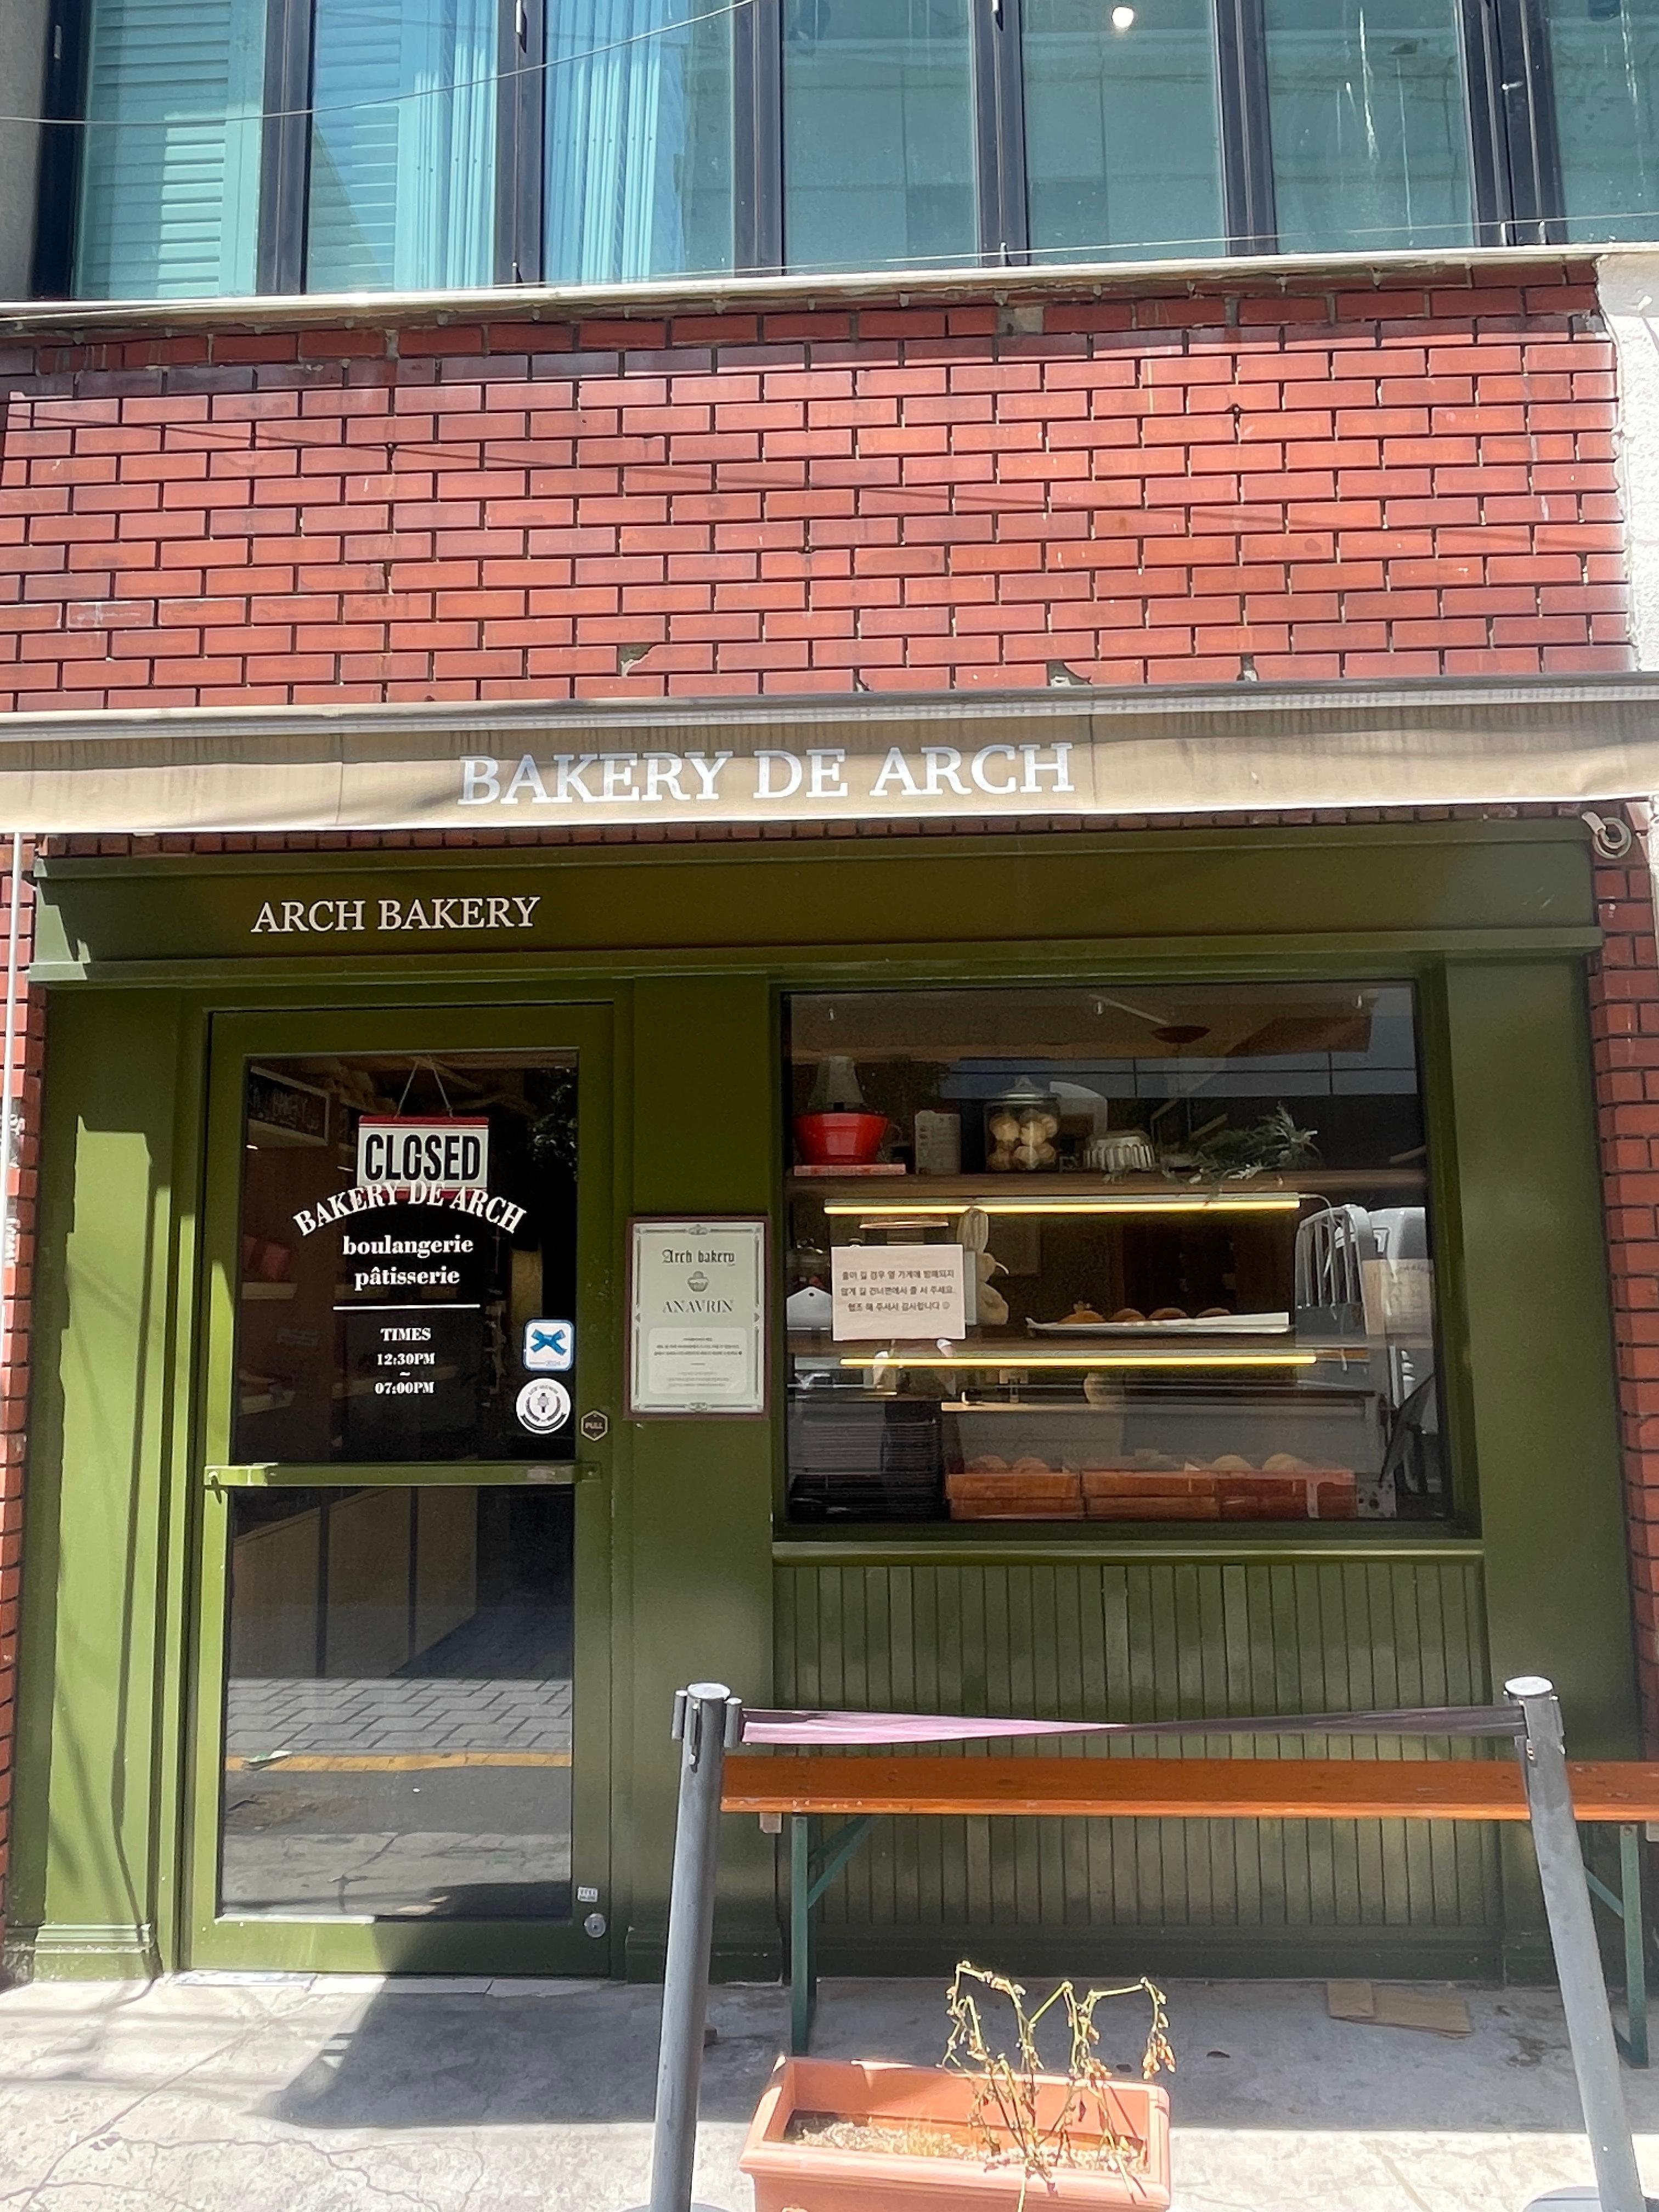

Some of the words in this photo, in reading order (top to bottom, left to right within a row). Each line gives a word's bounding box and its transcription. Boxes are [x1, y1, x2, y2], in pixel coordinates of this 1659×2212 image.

[458, 751, 737, 806] BAKERY
[753, 748, 848, 800] DE
[870, 742, 1075, 797] ARCH
[250, 900, 366, 933] ARCH
[377, 896, 541, 930] BAKERY
[365, 1133, 481, 1181] CLOSED
[292, 1181, 401, 1237] BAKERY
[407, 1180, 445, 1206] DE
[449, 1187, 528, 1234] ARCH
[342, 1234, 474, 1259] boulangerie
[354, 1266, 460, 1291] pâtisserie
[860, 1271, 867, 1280] 길
[870, 1271, 884, 1280] 경우
[898, 1270, 921, 1279] 가게에
[923, 1269, 955, 1279] 방해되지
[860, 1287, 866, 1296] 길
[869, 1286, 907, 1296] 건너편에서
[910, 1286, 917, 1295] 줄
[920, 1286, 927, 1295] 서
[848, 1302, 862, 1312] 협조
[876, 1302, 899, 1312] 주셔서
[902, 1301, 940, 1311] 감사합니다
[380, 1327, 431, 1342] TIMES
[376, 1352, 436, 1366] 12:30PM
[374, 1381, 435, 1395] 07:00PM
